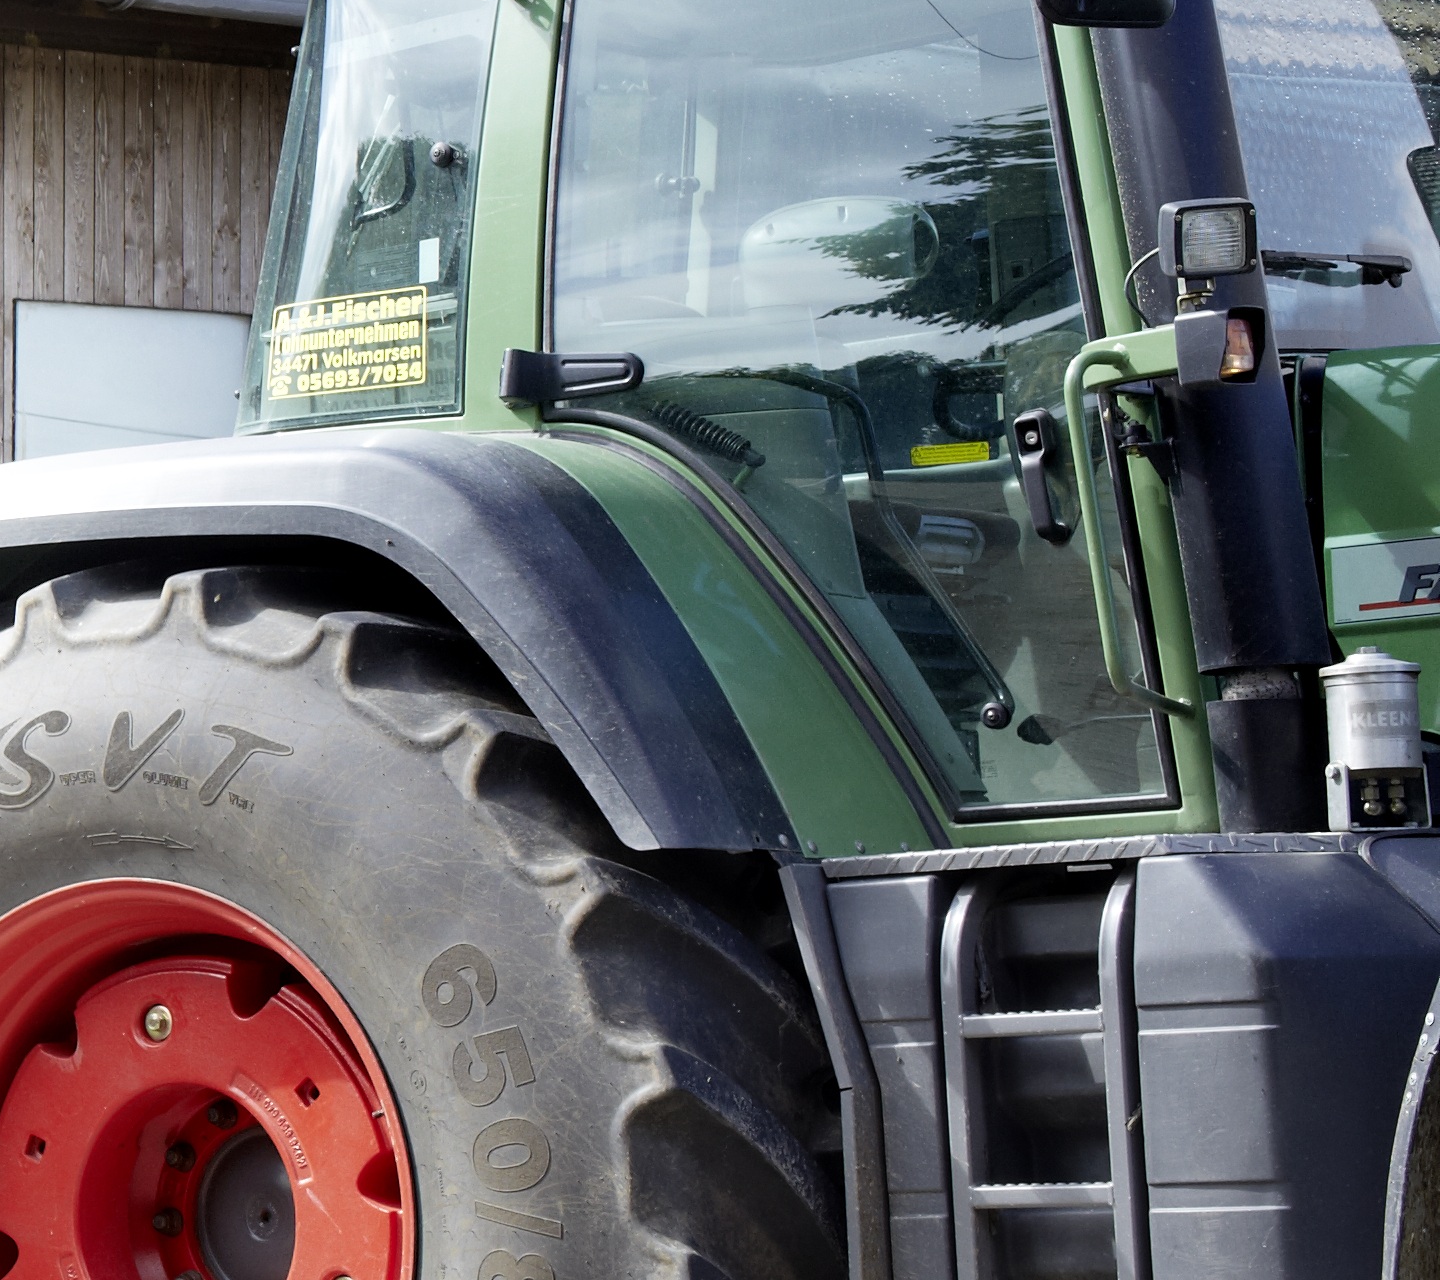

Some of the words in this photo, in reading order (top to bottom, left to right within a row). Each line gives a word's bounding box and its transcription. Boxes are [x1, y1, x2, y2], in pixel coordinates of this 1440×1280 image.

[274, 320, 420, 356] Lohnunternehmen
[272, 353, 318, 376] 34471
[322, 344, 421, 369] Volkmarsen
[297, 361, 423, 392] 05693/7034
